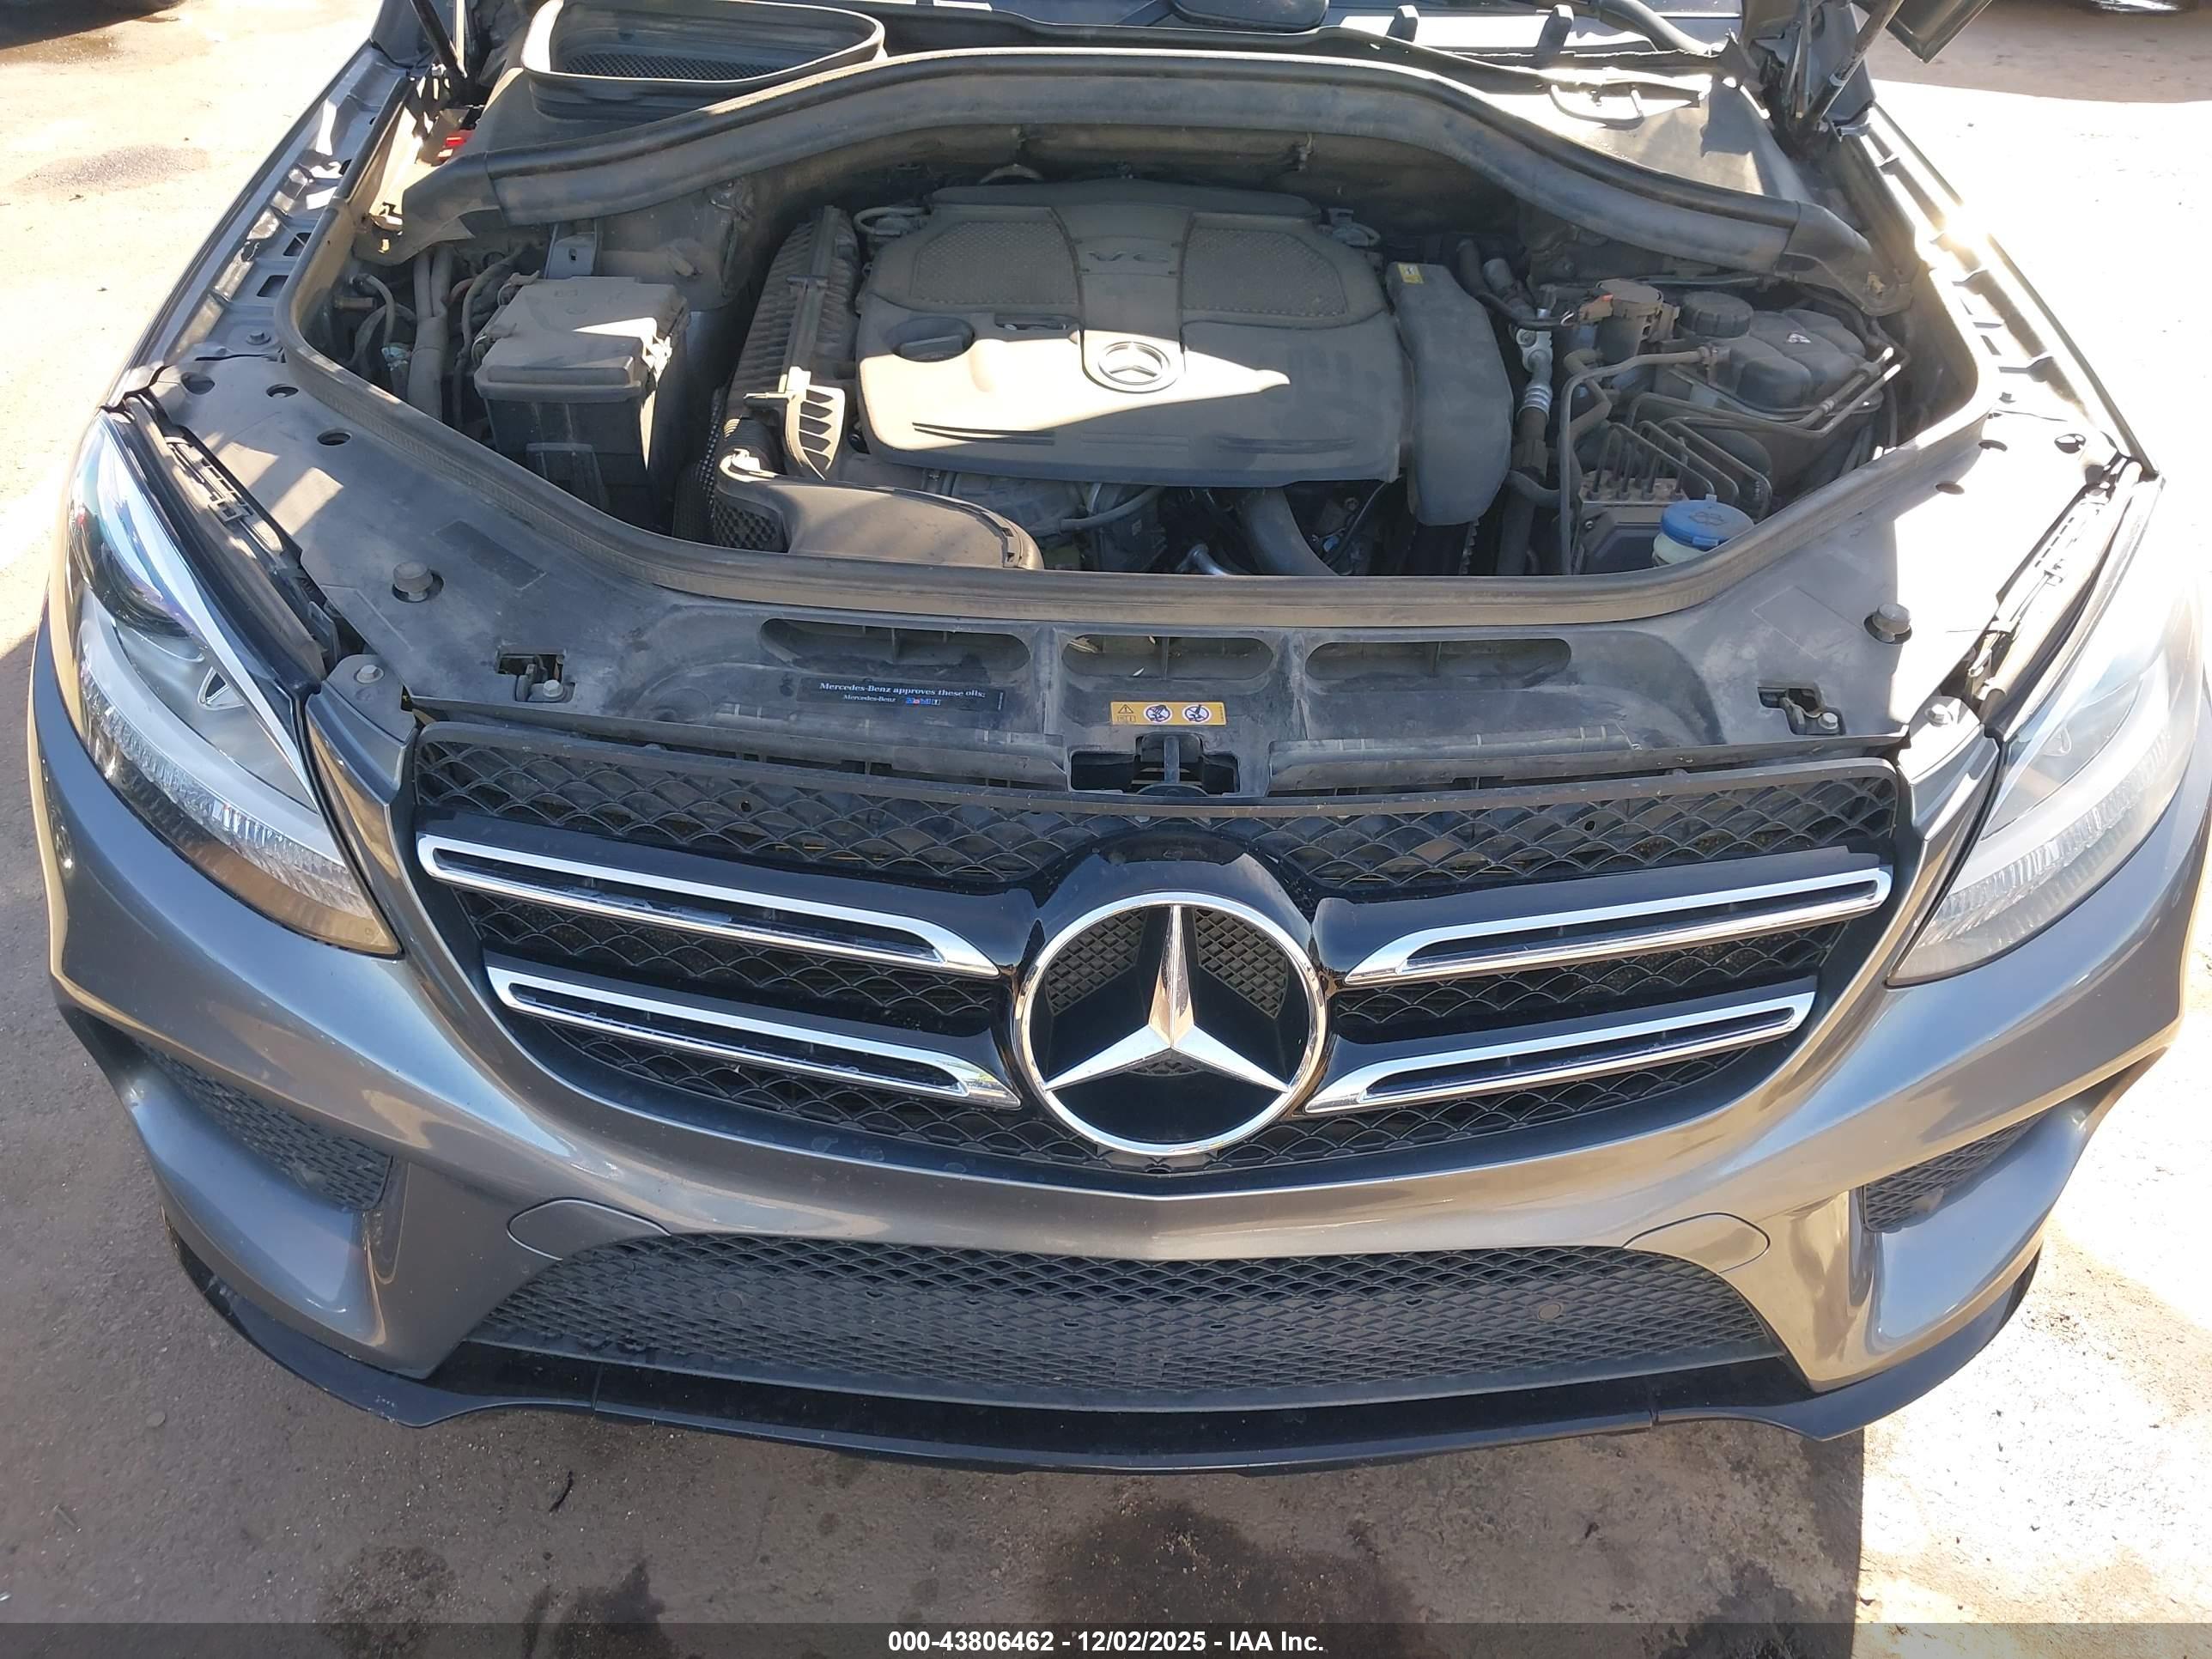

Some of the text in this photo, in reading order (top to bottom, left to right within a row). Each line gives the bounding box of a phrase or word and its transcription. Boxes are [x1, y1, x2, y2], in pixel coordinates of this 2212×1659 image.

[819, 682, 891, 693] Mercedes-Benz
[892, 687, 936, 696] approves
[938, 688, 963, 696] these
[842, 694, 896, 702] Mercedes-Benz
